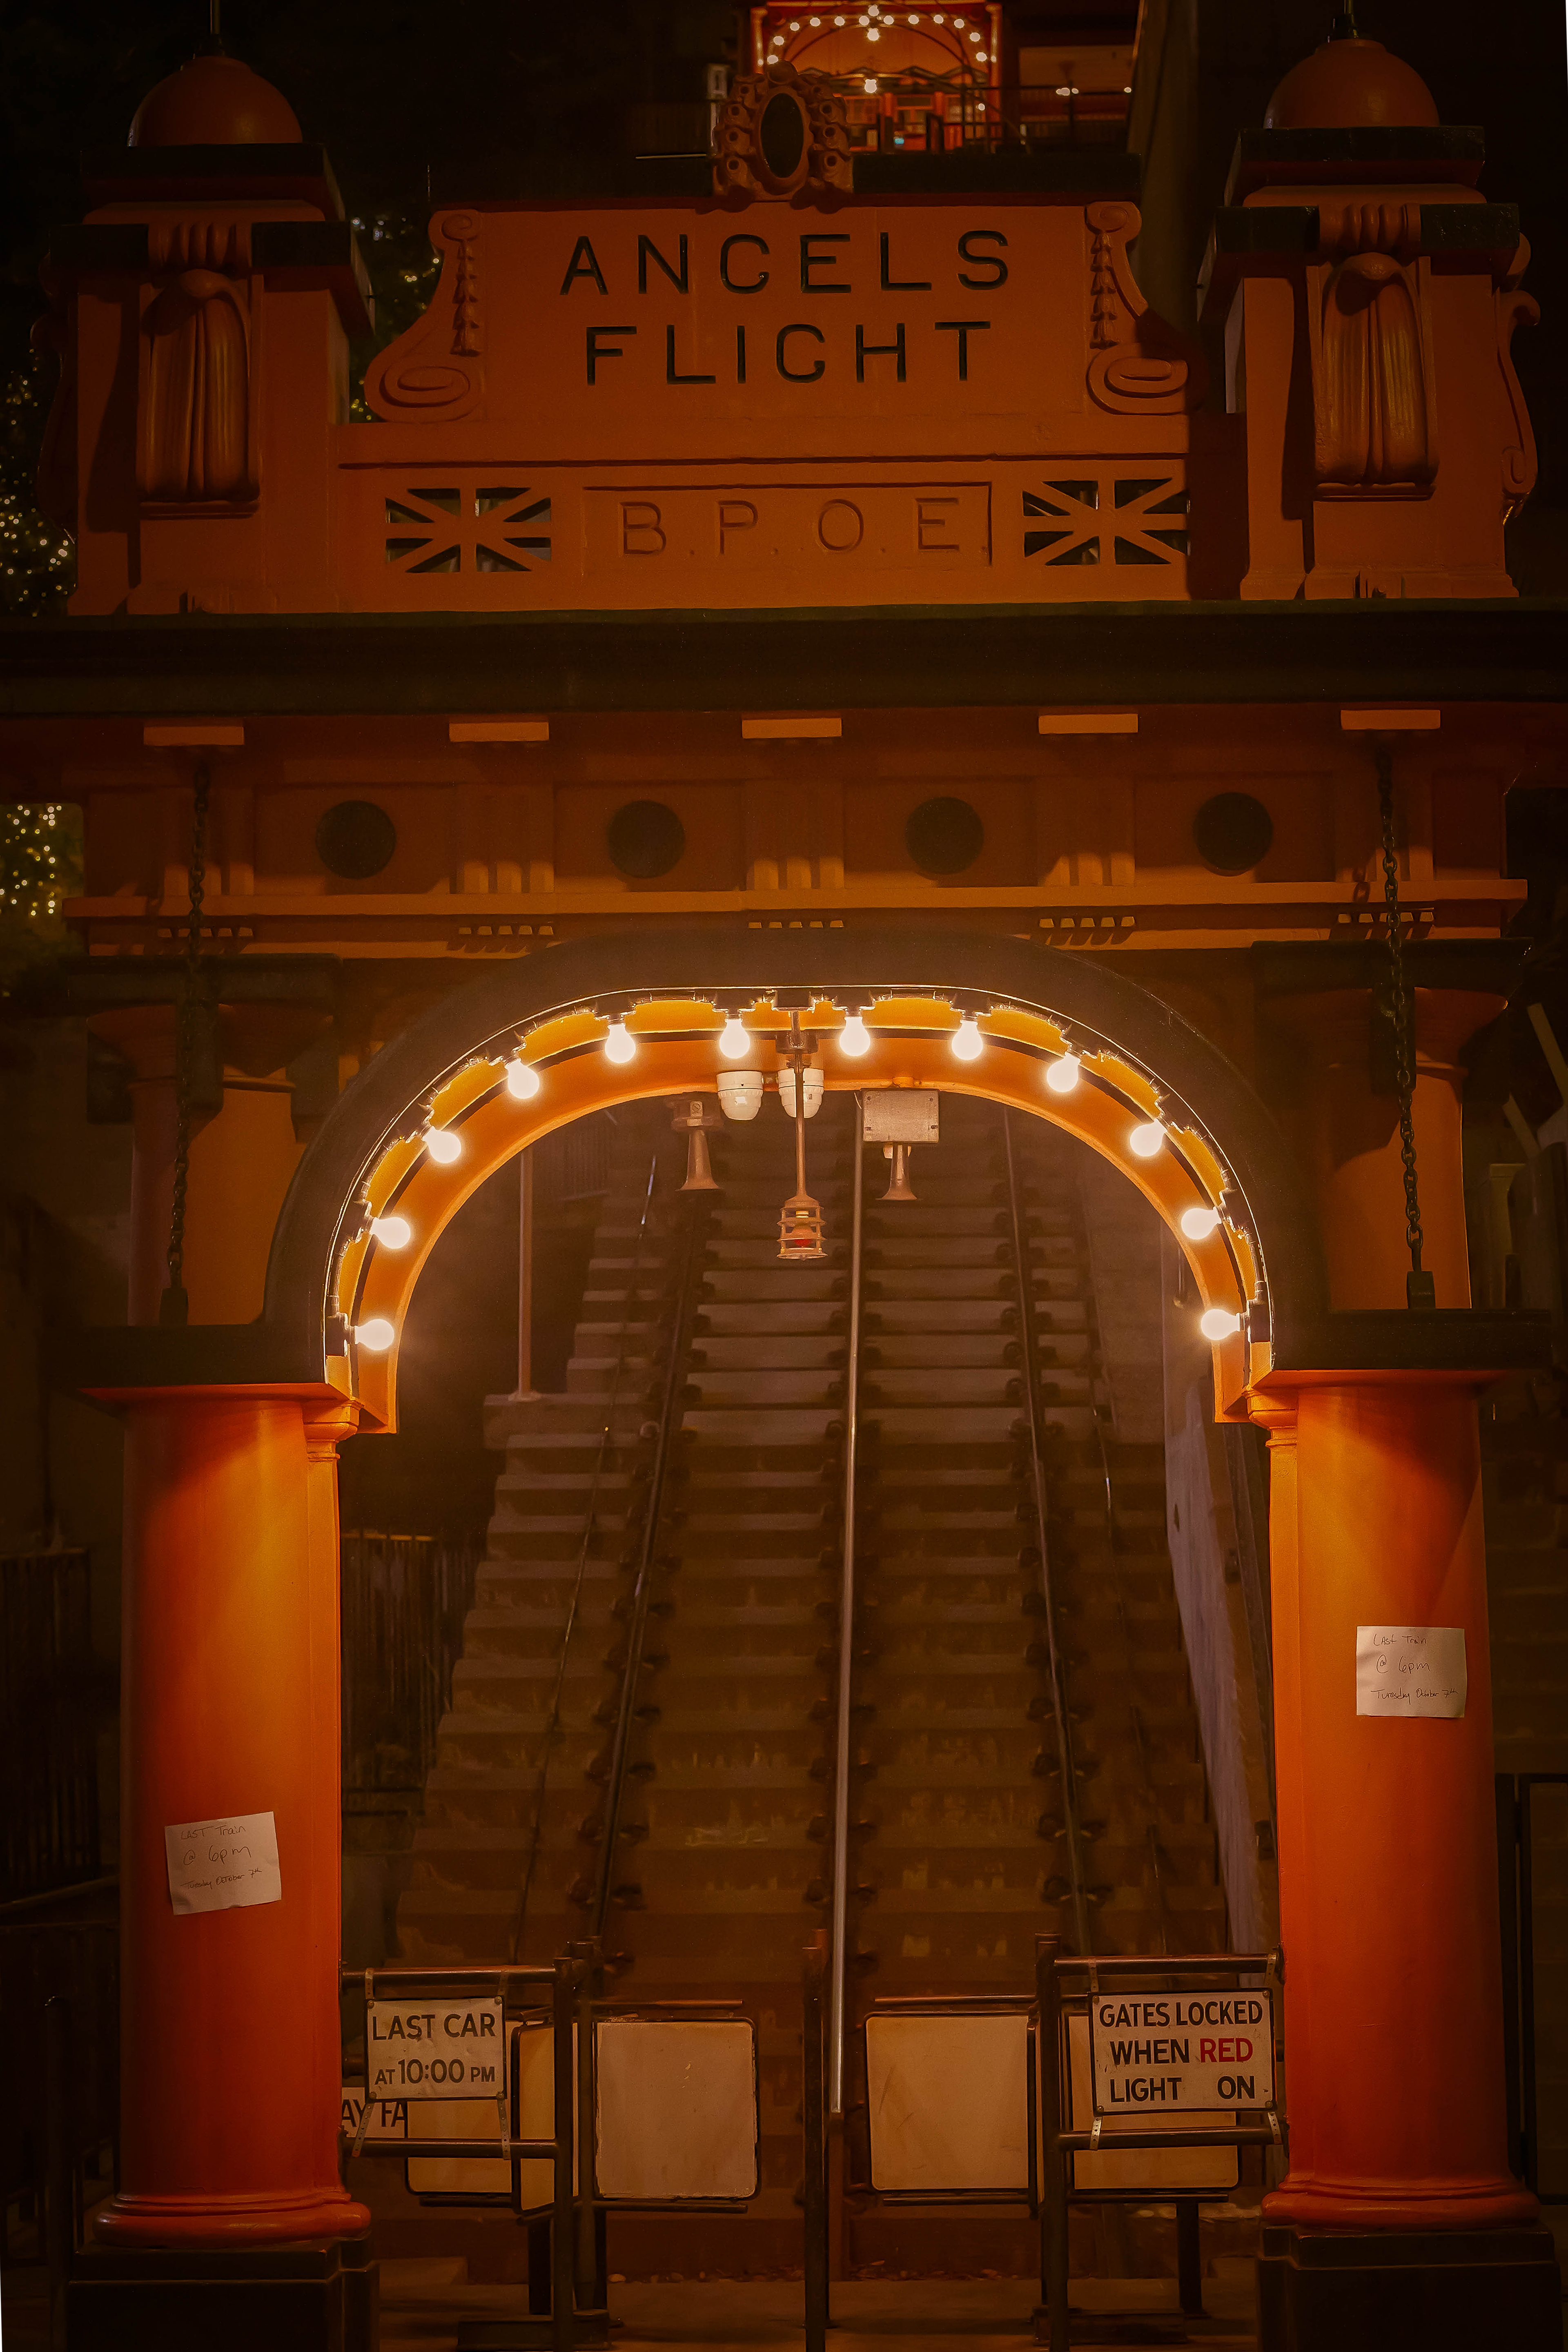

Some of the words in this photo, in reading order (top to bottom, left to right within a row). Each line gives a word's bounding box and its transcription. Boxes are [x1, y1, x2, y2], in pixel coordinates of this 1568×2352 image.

[560, 230, 1009, 295] ANGELS
[586, 321, 991, 385] FLIGHT
[1376, 1655, 1388, 1673] @
[183, 1849, 196, 1866] @
[372, 2015, 435, 2040] LAST
[443, 2013, 496, 2038] CAR
[1099, 2002, 1170, 2027] GATES
[1176, 2000, 1263, 2026] LOCKED
[1110, 2038, 1190, 2065] WHEN
[1200, 2038, 1253, 2063] RED
[374, 2069, 395, 2085] AT
[398, 2059, 465, 2084] 10:00
[470, 2066, 495, 2082] PM
[1110, 2077, 1182, 2103] LIGHT
[1217, 2075, 1255, 2099] ON
